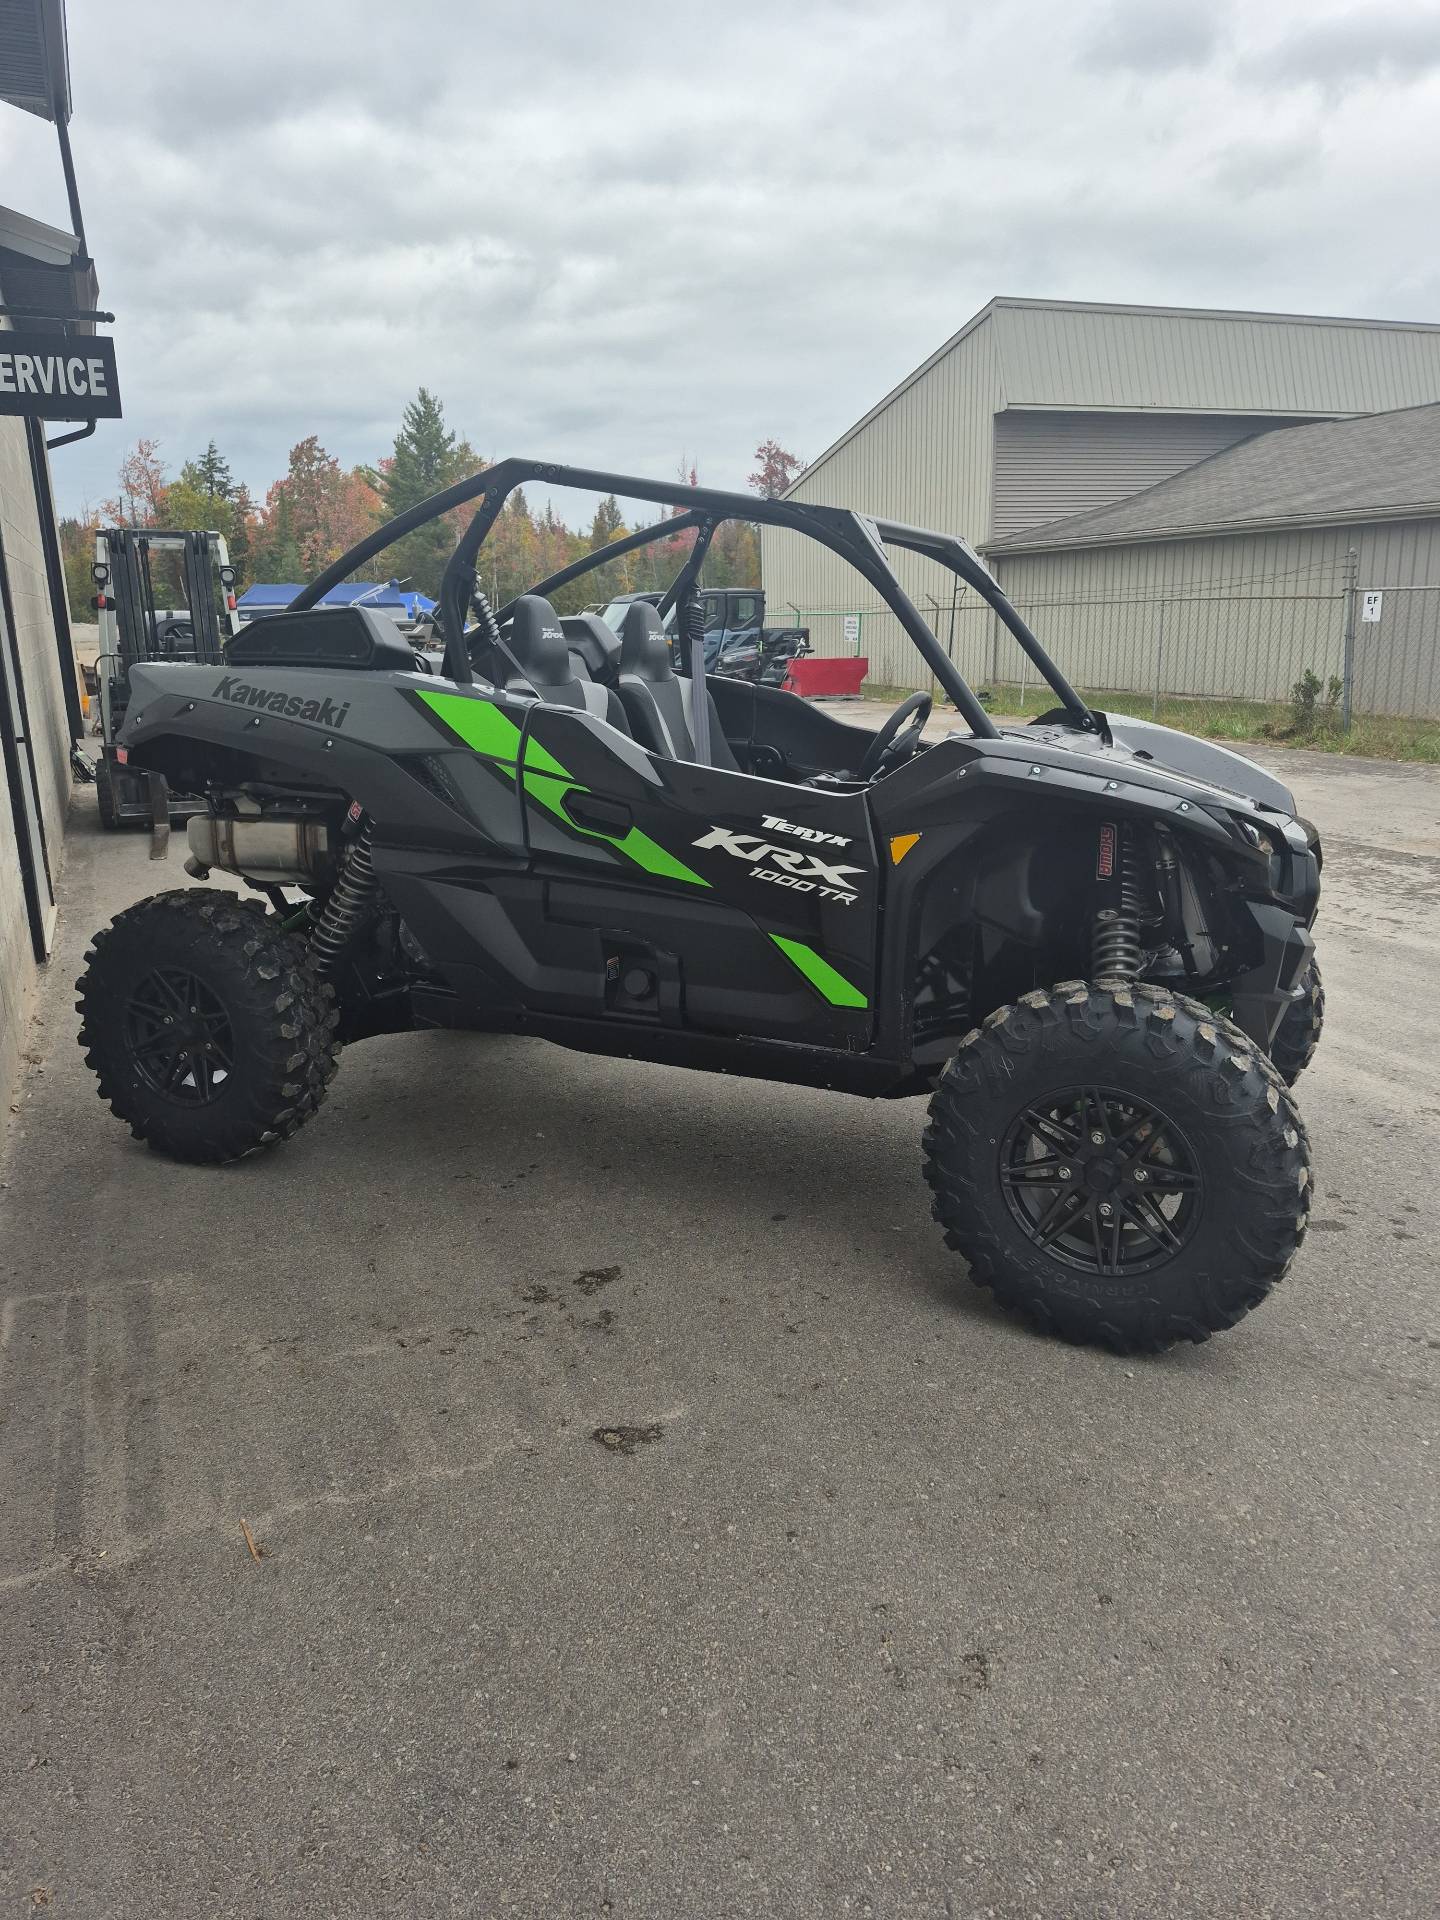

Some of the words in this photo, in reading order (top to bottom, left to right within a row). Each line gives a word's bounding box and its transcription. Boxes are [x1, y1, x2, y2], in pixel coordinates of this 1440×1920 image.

[0, 353, 108, 397] ERVICE
[1367, 596, 1379, 605] EF
[1369, 606, 1374, 615] 1
[211, 675, 352, 729] Kawasaki
[761, 814, 853, 847] TERYX
[691, 825, 869, 891] KRX
